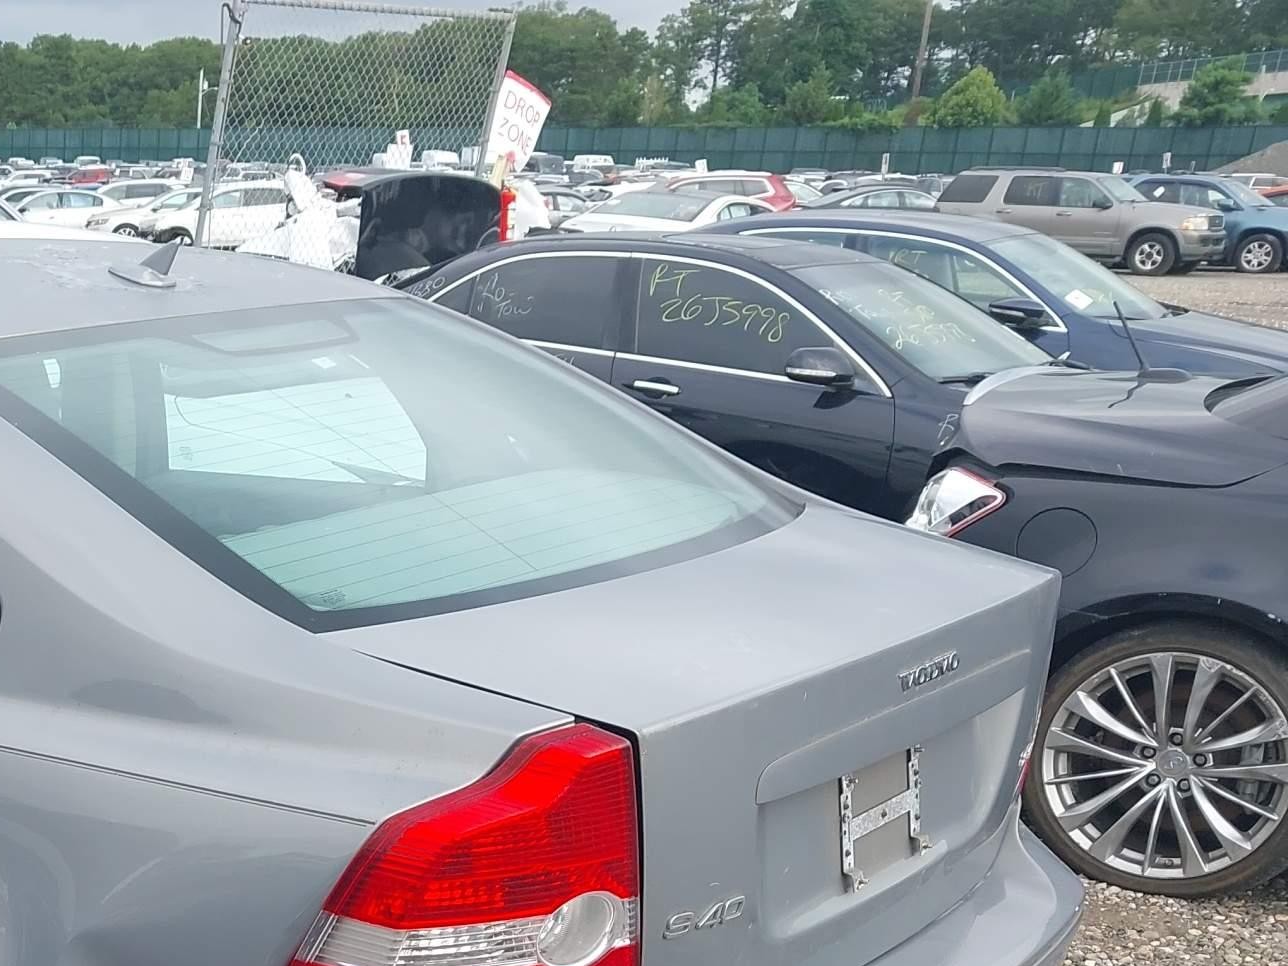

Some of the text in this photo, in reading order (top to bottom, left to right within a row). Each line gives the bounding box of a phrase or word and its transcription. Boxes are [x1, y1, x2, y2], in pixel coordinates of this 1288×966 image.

[504, 90, 541, 126] DROP
[497, 116, 533, 157] ZONE
[649, 264, 700, 297] RT
[896, 651, 961, 693] VOLVO
